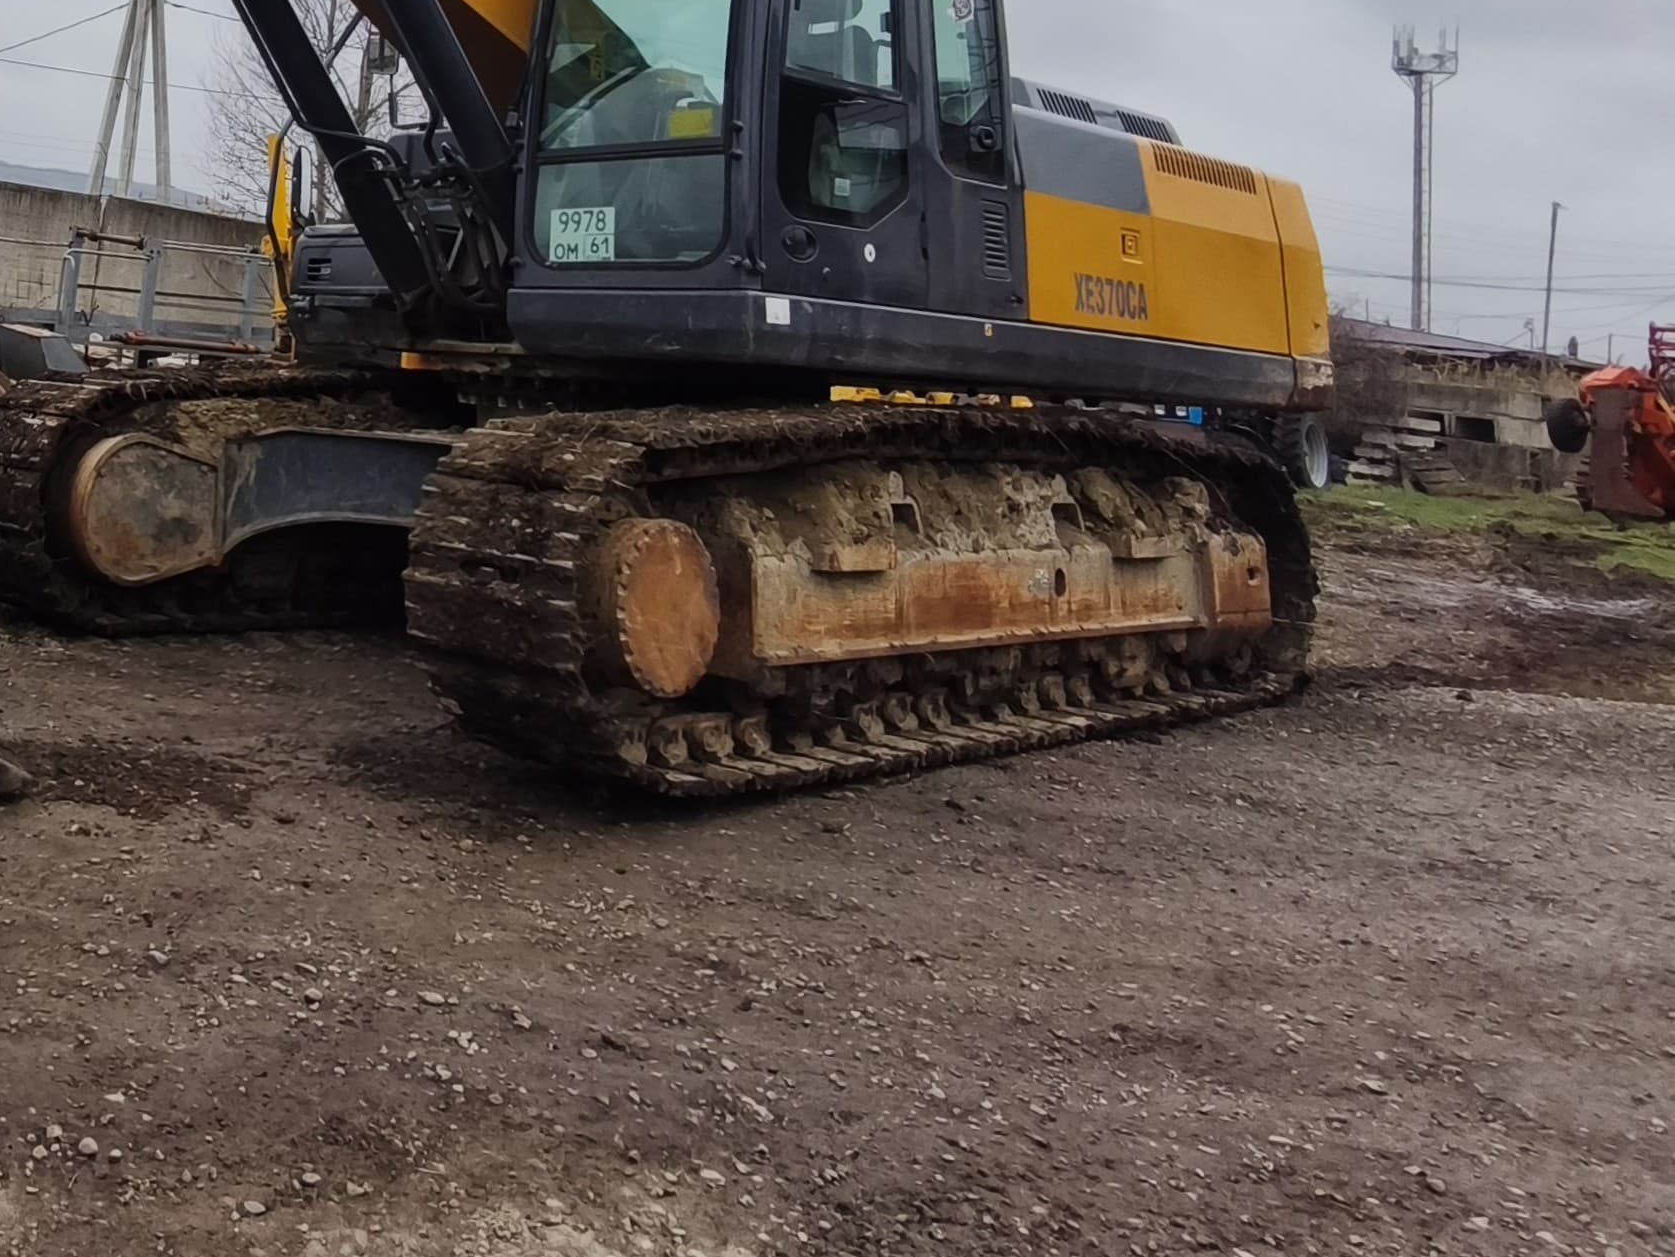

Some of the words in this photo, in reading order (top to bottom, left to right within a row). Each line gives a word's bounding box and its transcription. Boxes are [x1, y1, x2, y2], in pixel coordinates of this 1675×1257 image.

[559, 210, 606, 233] 9978
[590, 237, 609, 254] 61
[1074, 272, 1148, 321] XE370CA
